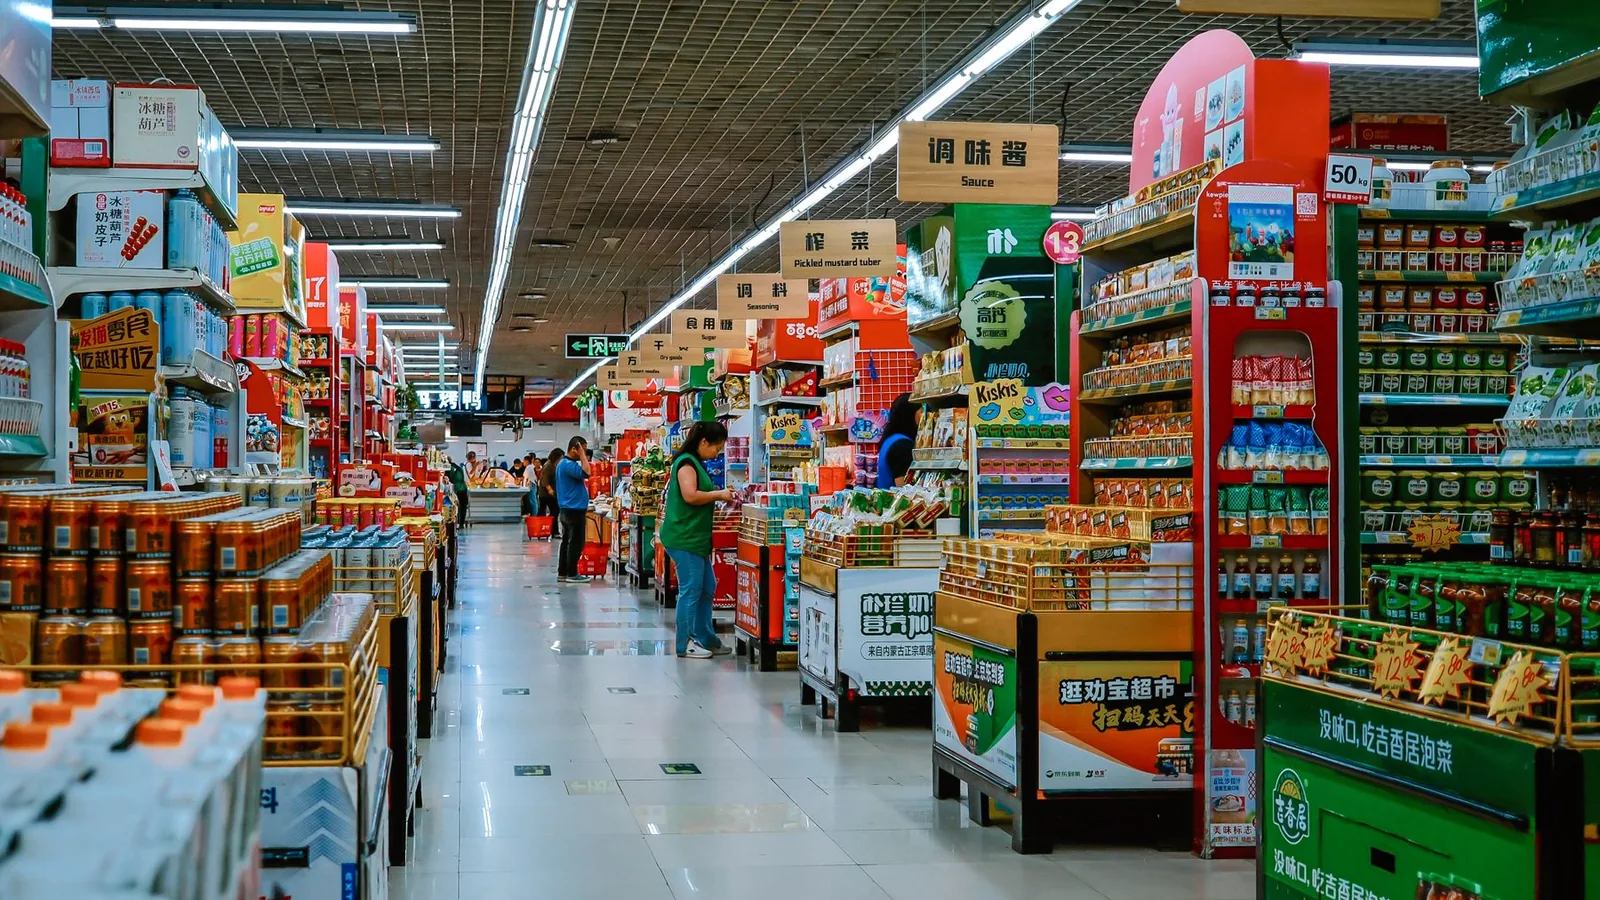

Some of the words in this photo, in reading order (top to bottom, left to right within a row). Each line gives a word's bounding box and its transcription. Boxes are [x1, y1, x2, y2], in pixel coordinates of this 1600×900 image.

[138, 102, 166, 115] 冰糖
[138, 117, 165, 130] 葫芦
[928, 137, 1027, 167] 调味酱
[961, 176, 994, 188] Sauce
[1330, 164, 1357, 185] 50
[1358, 177, 1368, 187] kg
[109, 196, 122, 244] 冰糖葫芦
[94, 211, 109, 247] 奶皮子
[805, 231, 869, 252] 榨菜
[1048, 232, 1080, 254] 13
[794, 258, 823, 268] Pickled
[825, 257, 857, 267] mustard
[859, 257, 881, 267] tuber
[737, 282, 788, 298] 调料
[747, 302, 779, 312] Seasoning
[977, 306, 1006, 323] 高钙
[686, 316, 733, 331] 食用糖
[701, 334, 717, 342] Sugar
[78, 345, 156, 371] 吃越好吃
[627, 356, 637, 366] 方
[975, 382, 1019, 403] Kiskis
[770, 416, 798, 430] Kiskis
[862, 594, 934, 614] 朴珍奶
[1410, 611, 1427, 621] 三丝
[862, 615, 934, 638] 营养加
[868, 645, 934, 657] 来自内蒙古正宗草原
[1060, 676, 1175, 704] 逛劝宝超市
[1054, 770, 1081, 778] 京东到家
[1275, 797, 1309, 832] 吉香居
[1214, 825, 1253, 835] 美味标志
[1273, 848, 1392, 900] 没味口,吃吉香居泡
